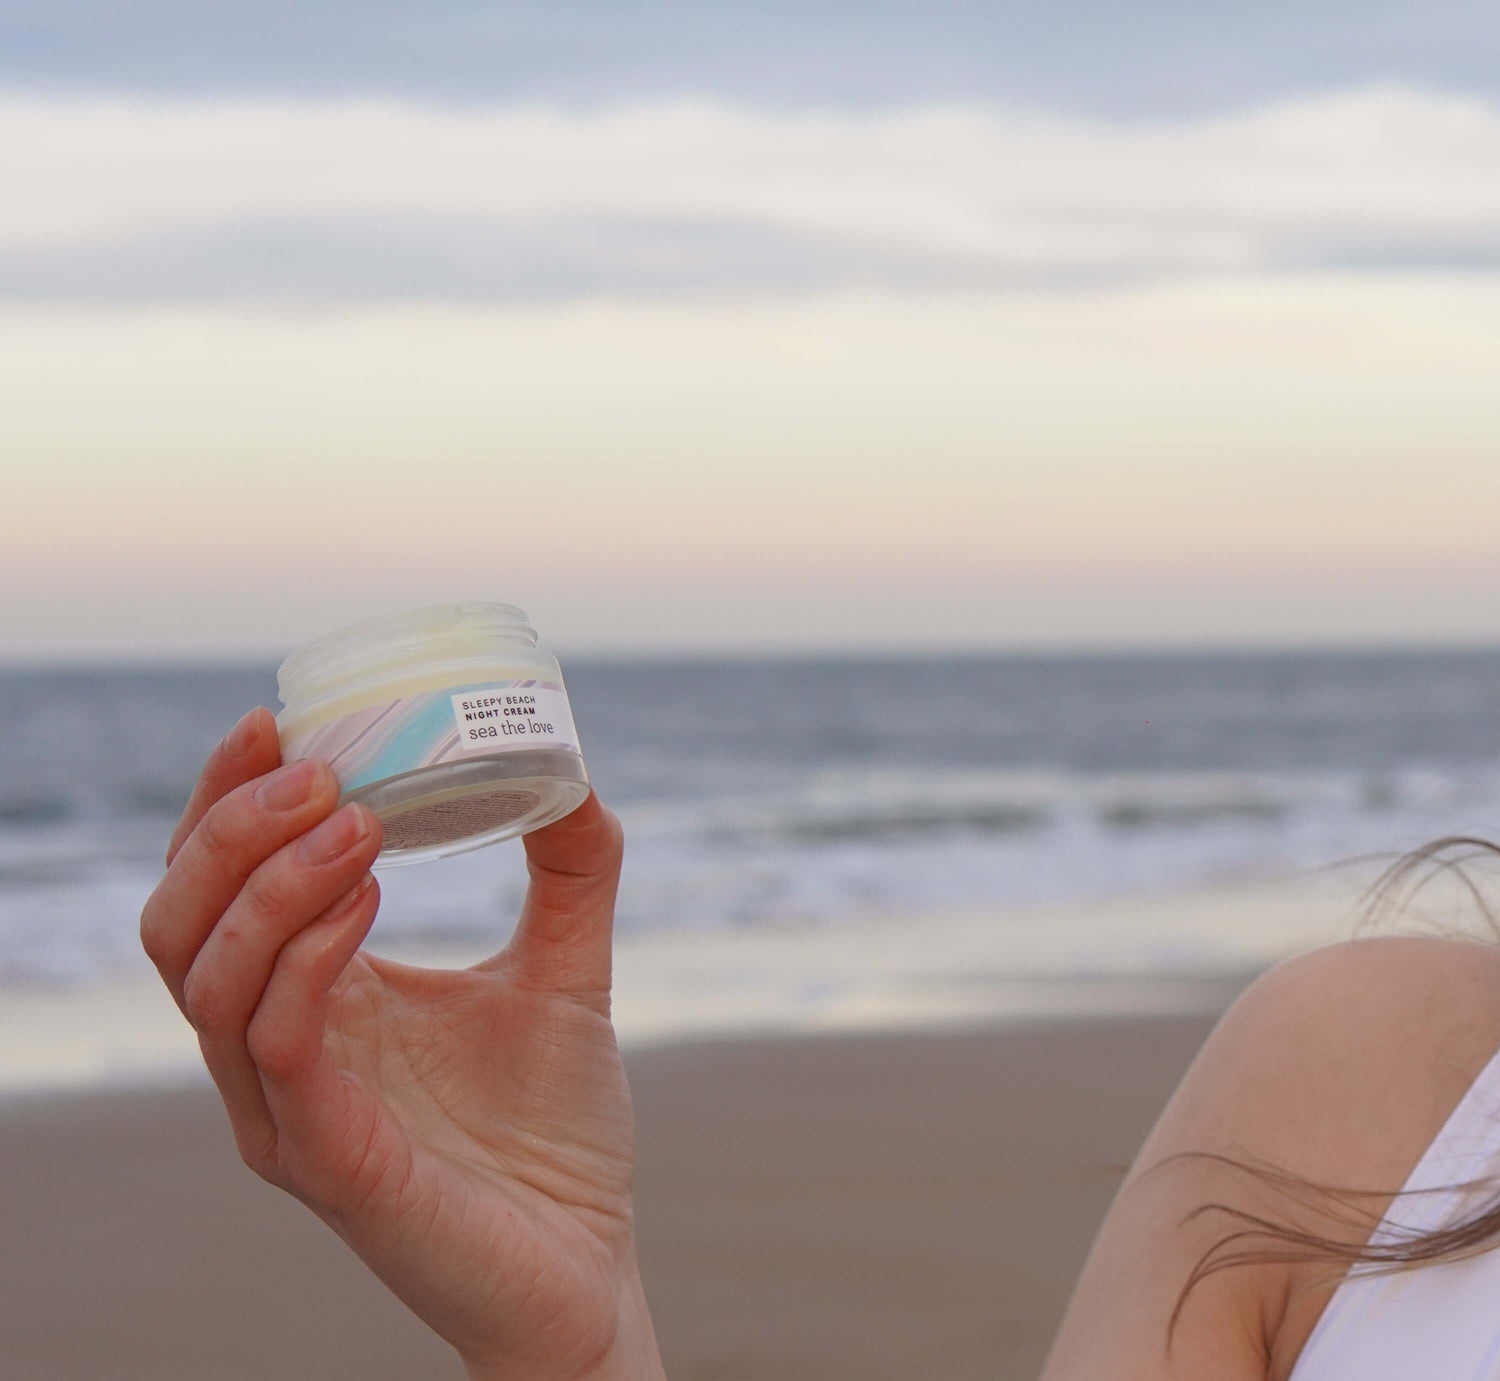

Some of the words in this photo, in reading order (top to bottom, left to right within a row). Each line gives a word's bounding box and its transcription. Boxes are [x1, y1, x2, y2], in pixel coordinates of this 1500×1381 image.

[462, 697, 502, 710] SLEEPY
[506, 695, 536, 705] BEACH
[465, 709, 499, 721] NIGHT
[503, 707, 536, 716] CREAM
[469, 726, 498, 740] sea
[500, 719, 526, 736] the
[527, 718, 554, 734] love
